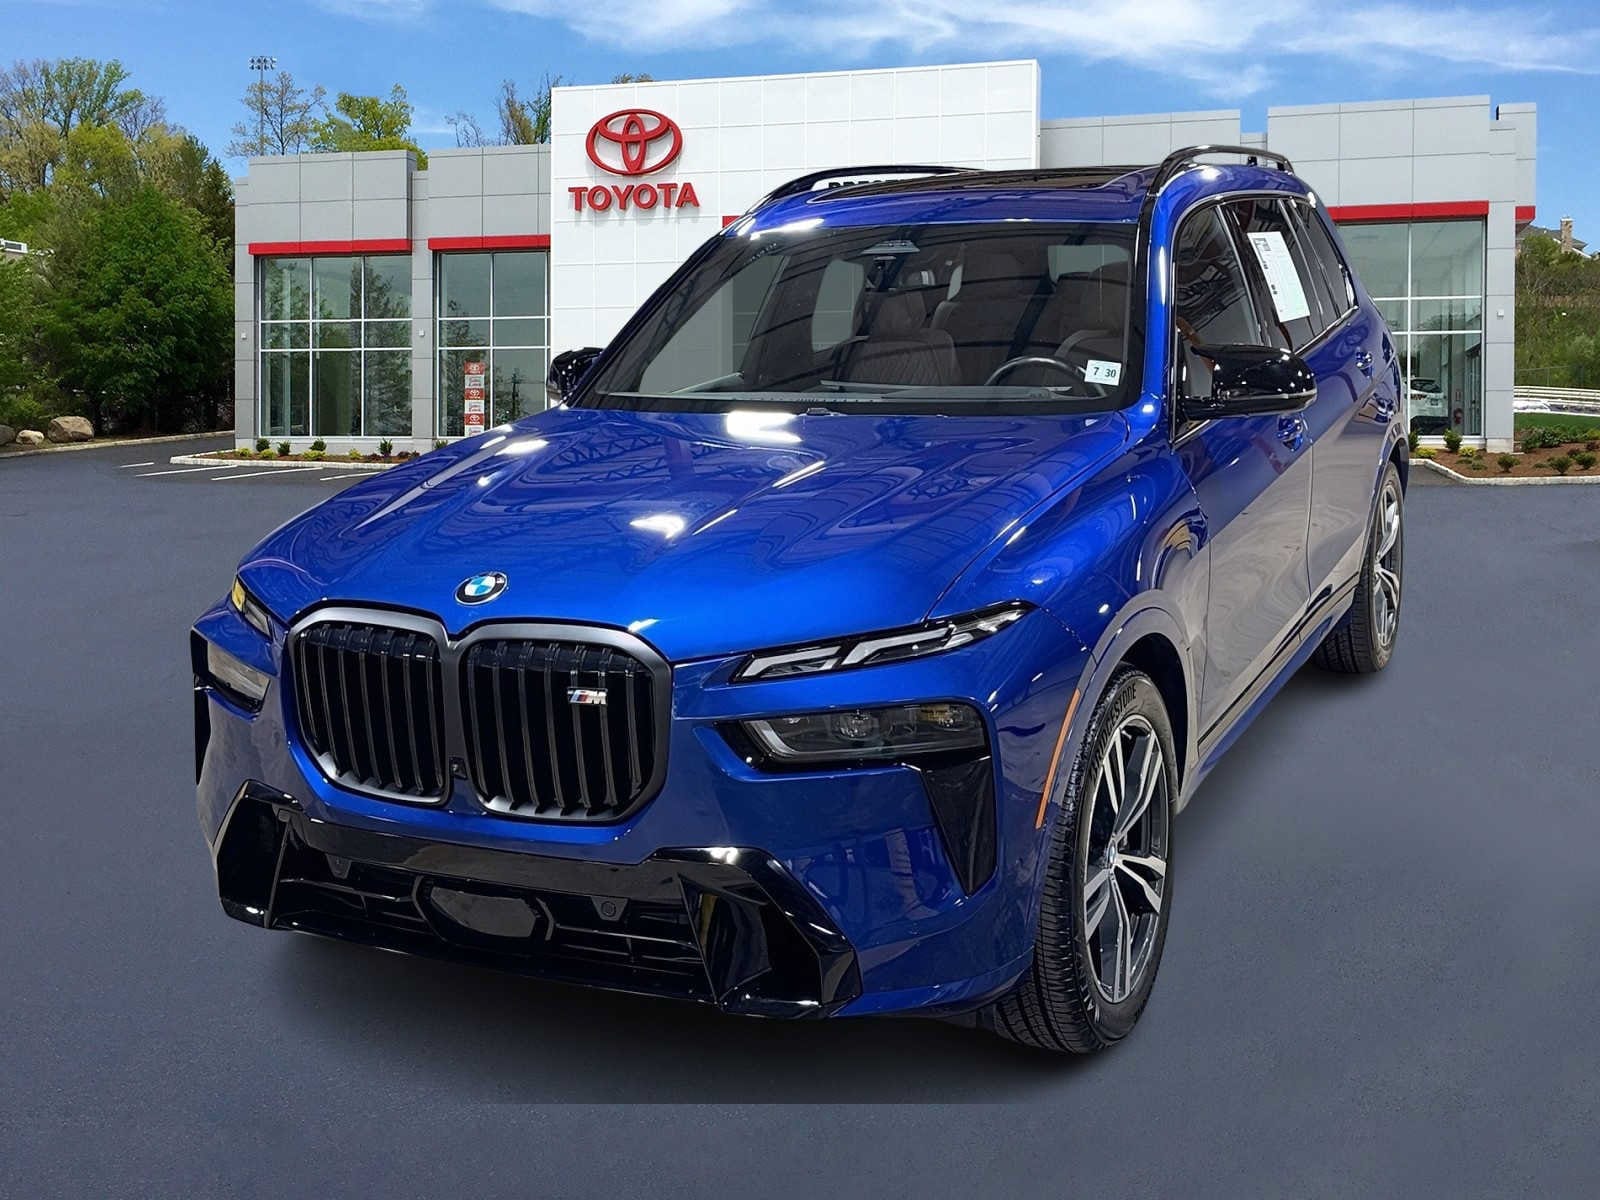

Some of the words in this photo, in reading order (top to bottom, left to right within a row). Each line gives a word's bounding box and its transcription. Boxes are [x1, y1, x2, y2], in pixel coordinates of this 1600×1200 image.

[568, 182, 700, 212] TOYOTA
[1093, 366, 1100, 376] 7
[1104, 368, 1117, 378] 30
